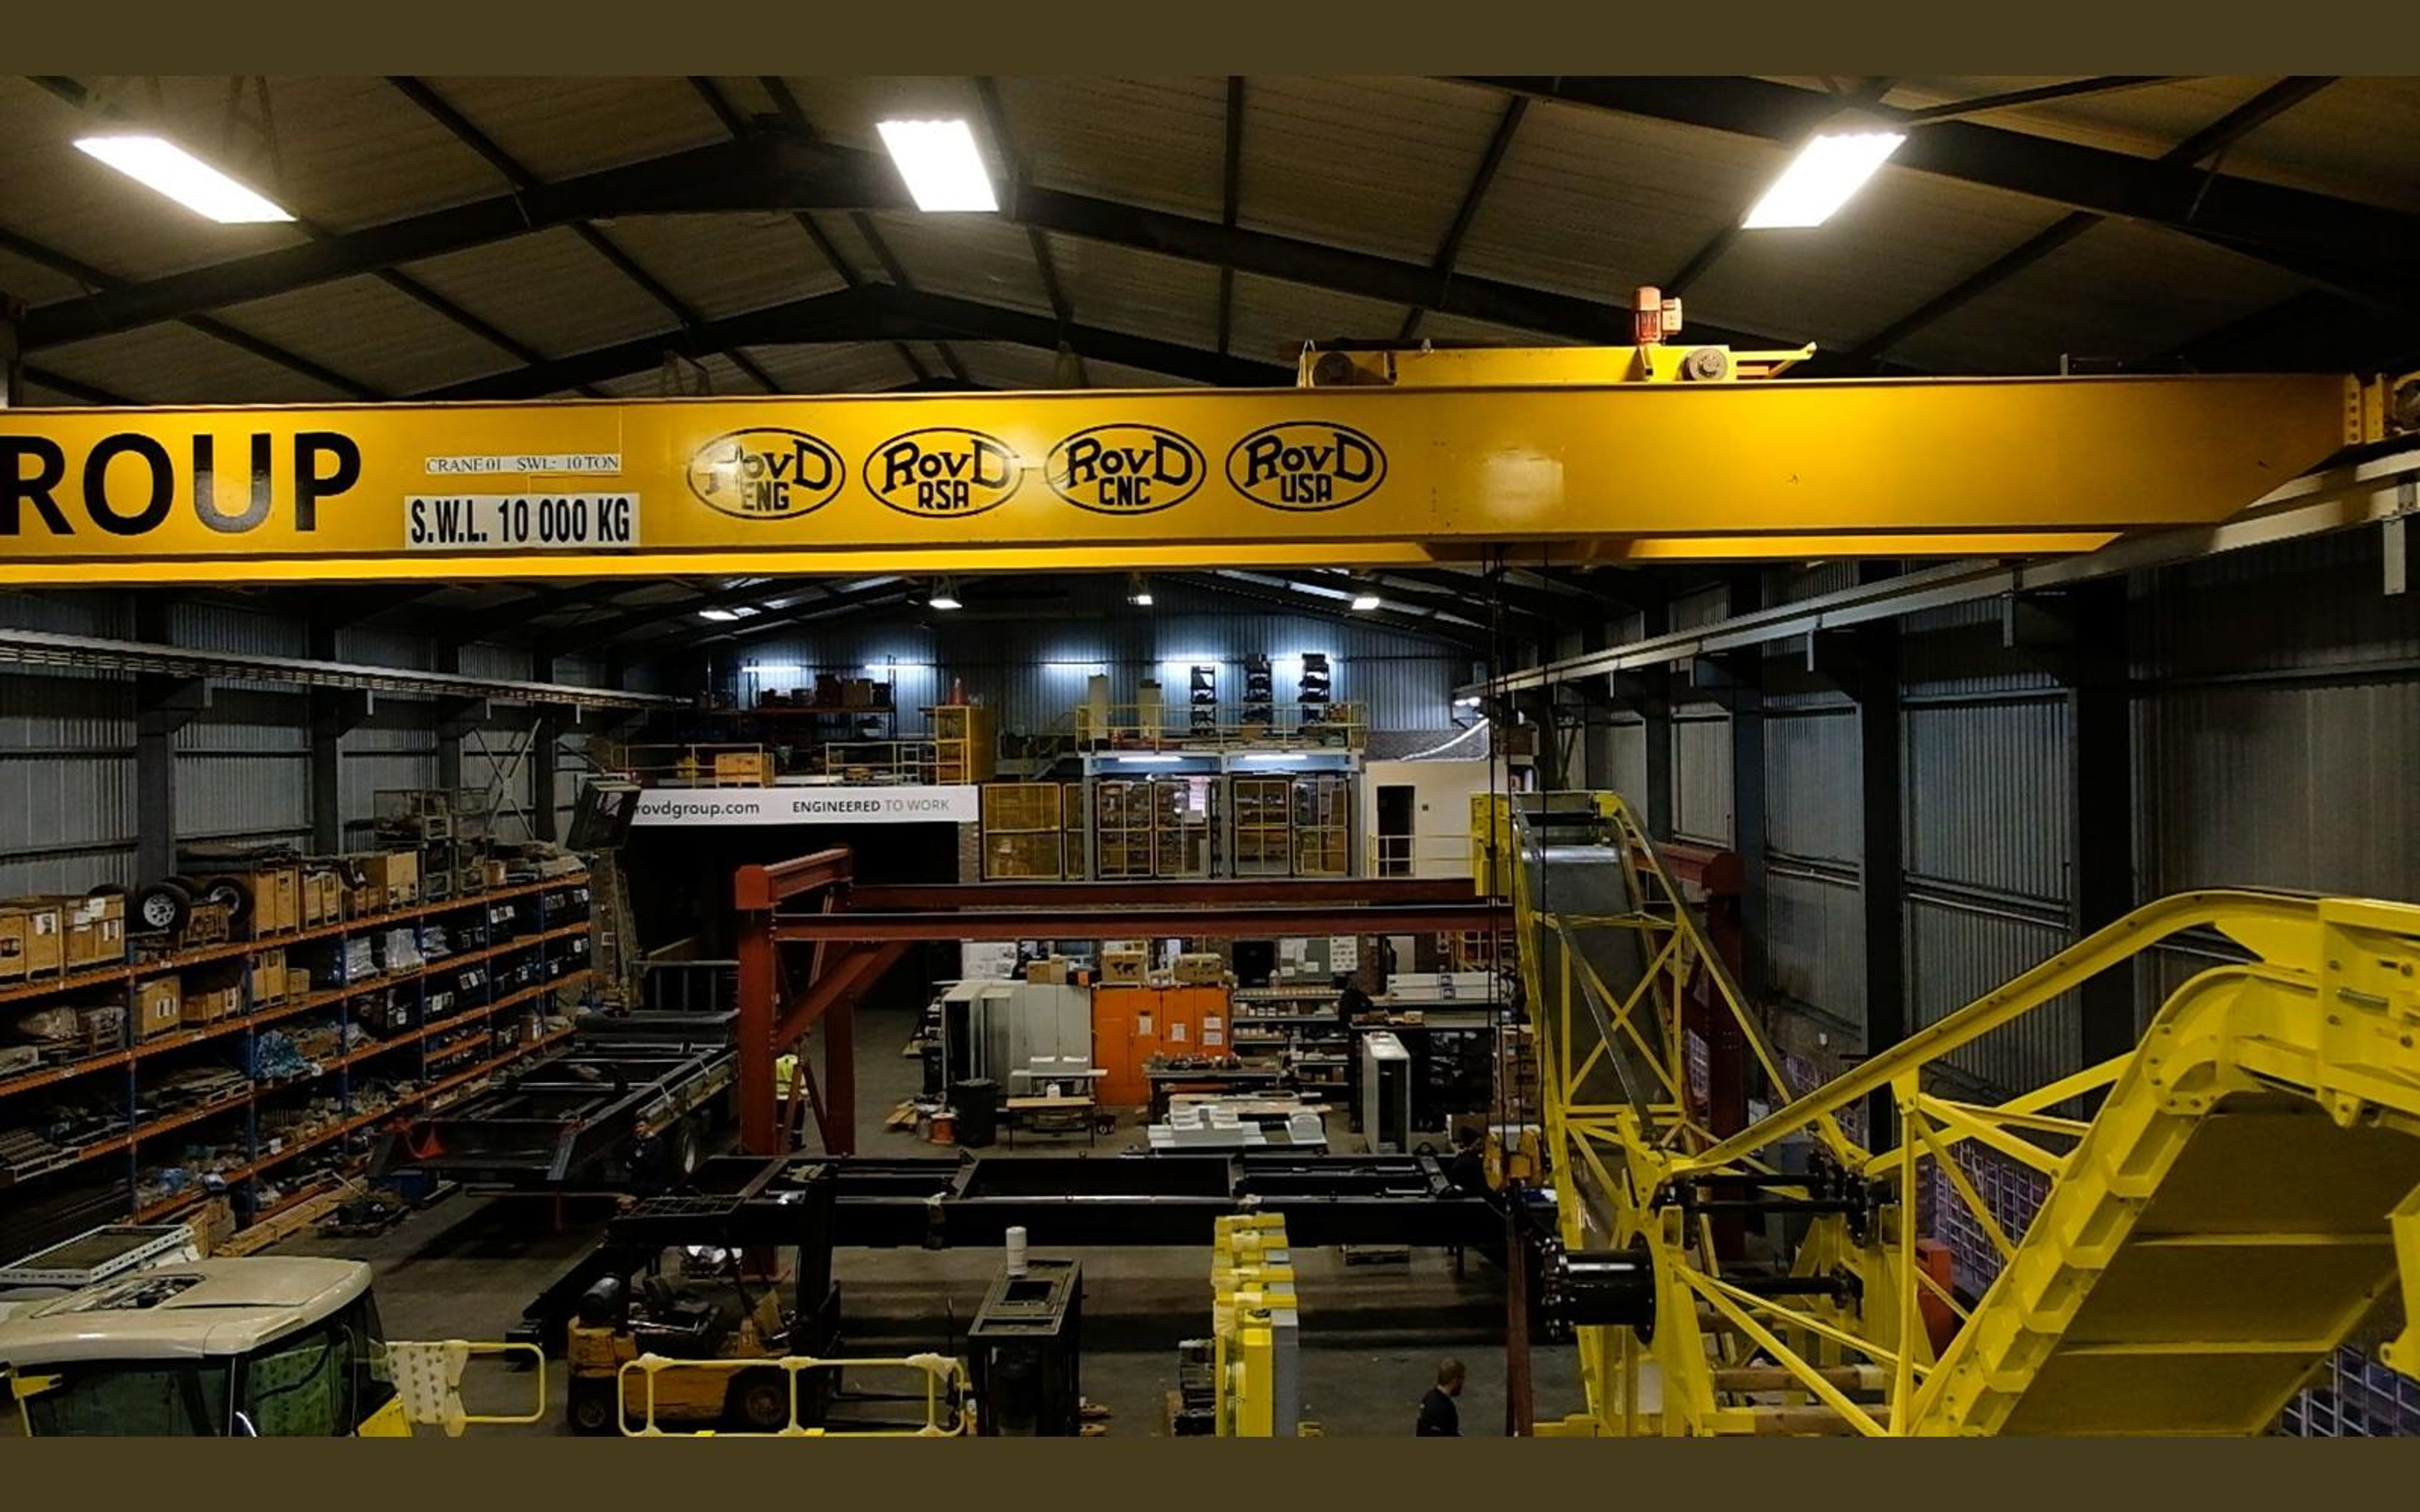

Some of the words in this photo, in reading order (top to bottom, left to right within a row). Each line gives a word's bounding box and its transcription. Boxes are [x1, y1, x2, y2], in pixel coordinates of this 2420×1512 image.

[427, 458, 484, 472] CRANE
[517, 457, 557, 471] SWL:
[568, 457, 582, 469] 10
[587, 455, 619, 469] TON
[0, 432, 361, 536] ROUP
[742, 481, 789, 511] ENG
[918, 481, 969, 509] RSA
[1099, 477, 1150, 506] CNC
[1281, 474, 1332, 503] USA
[412, 498, 487, 543] S.W.L.
[498, 499, 528, 542] 10
[539, 498, 587, 542] 000
[598, 498, 630, 542] KG
[793, 801, 880, 813] ENGINEERED
[885, 800, 903, 811] TO
[907, 799, 949, 811] WORK
